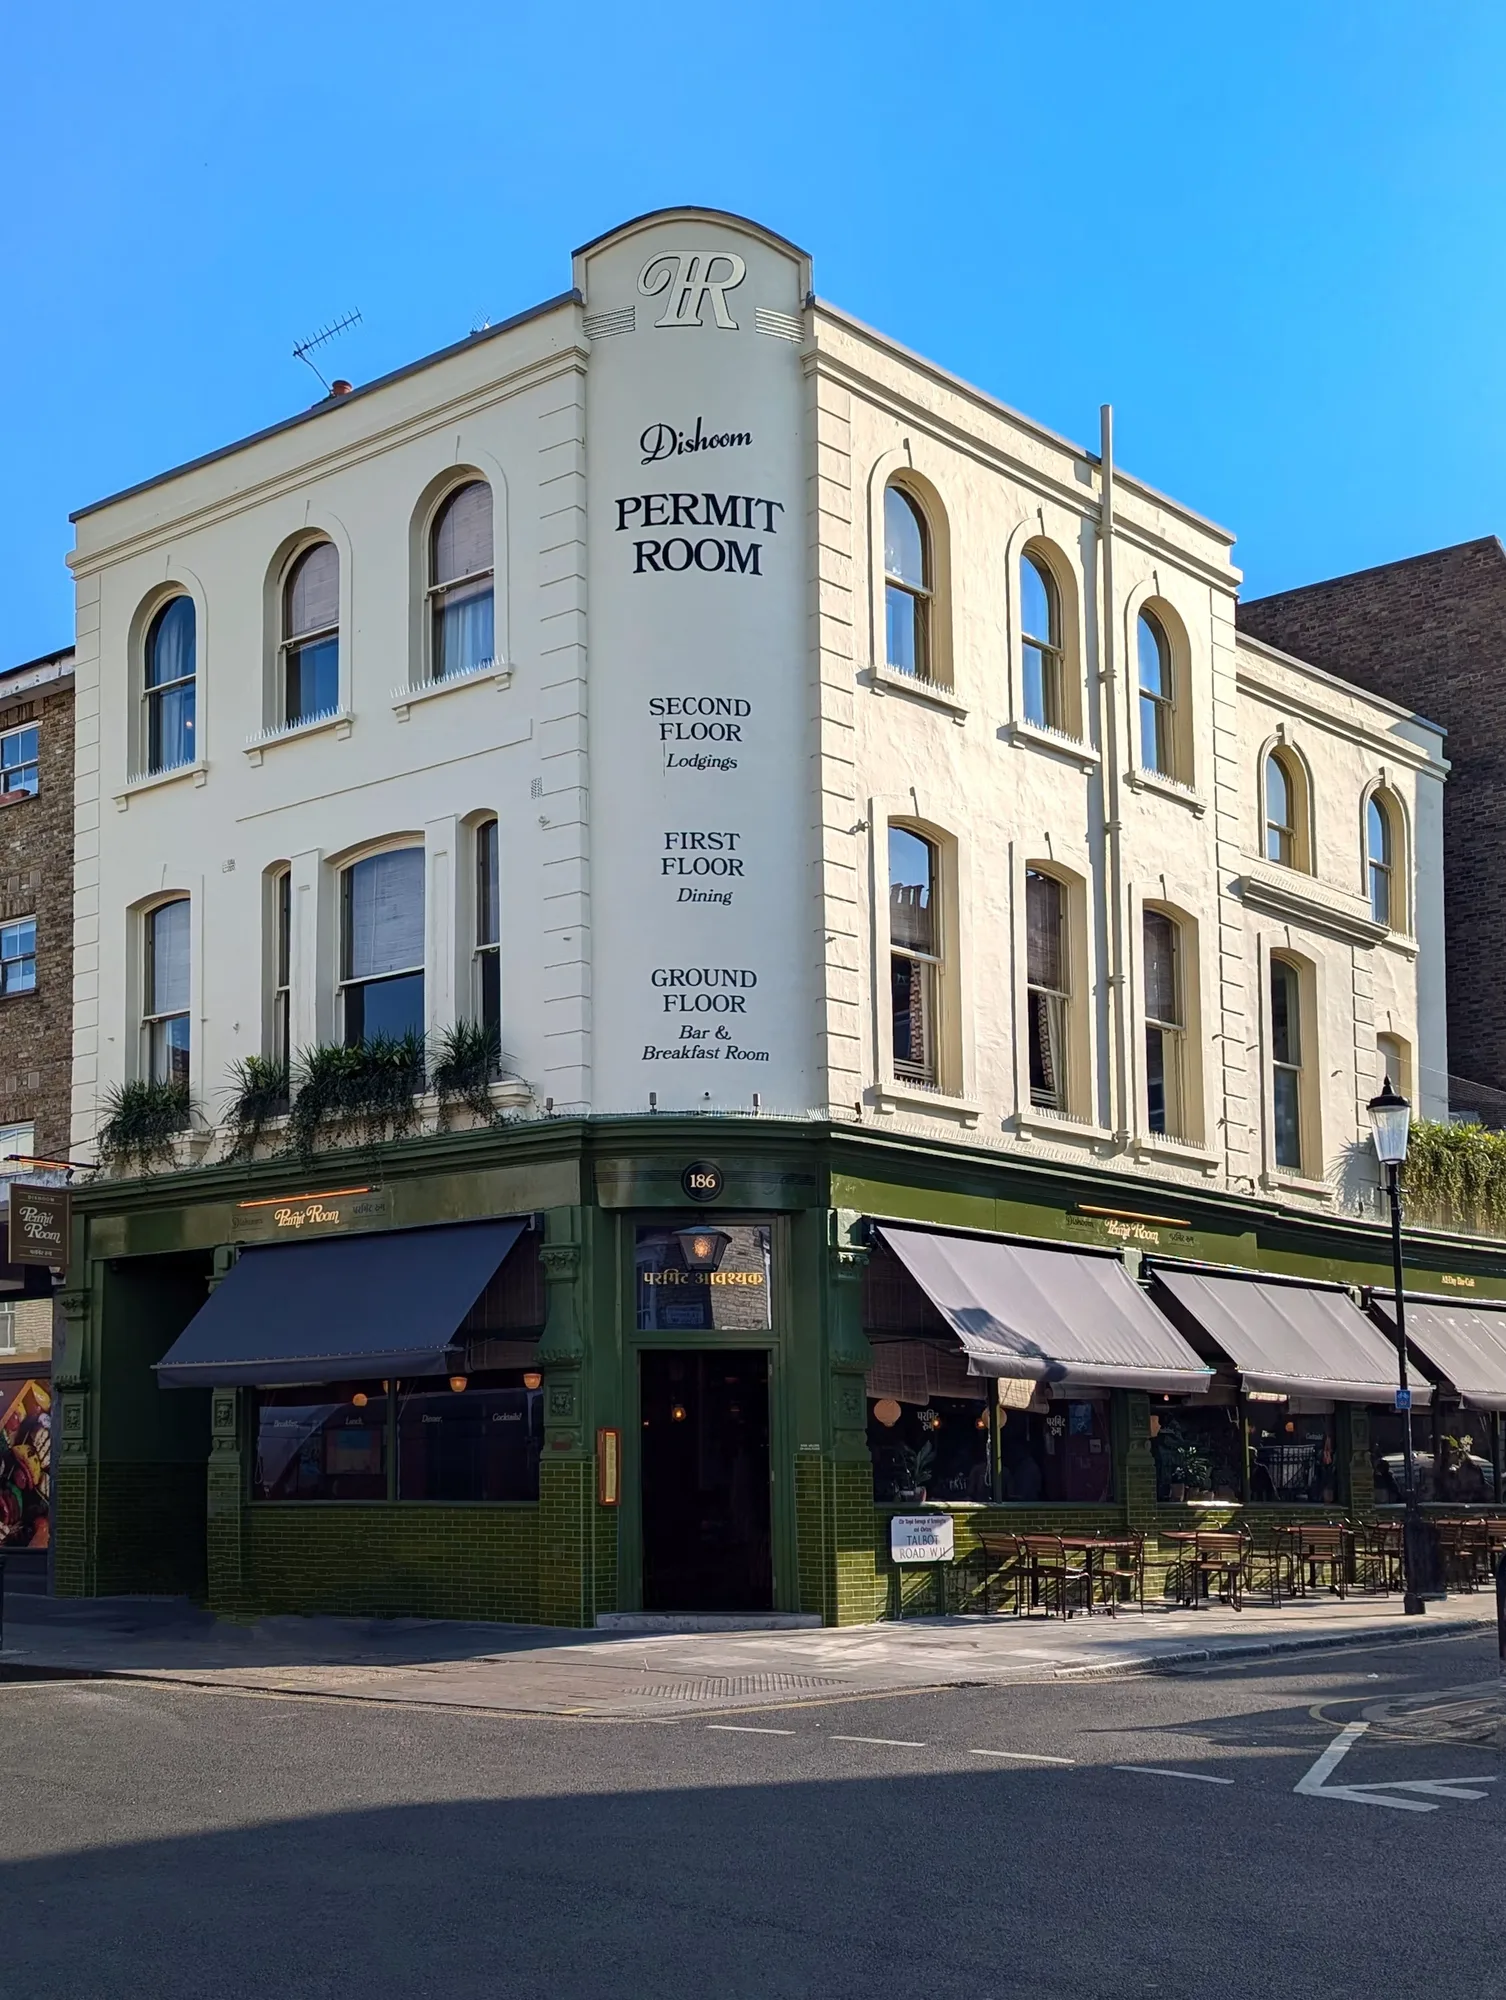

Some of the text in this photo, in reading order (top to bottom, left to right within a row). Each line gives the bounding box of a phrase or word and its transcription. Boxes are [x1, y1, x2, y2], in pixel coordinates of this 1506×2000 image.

[640, 416, 753, 465] Dishoom
[614, 493, 785, 533] PERMIT
[632, 538, 764, 576] ROOM
[649, 697, 751, 717] SECOND
[659, 722, 743, 742] FLOOR
[666, 753, 739, 771] Lodgings
[664, 832, 741, 851] FIRST
[661, 857, 745, 877] FLOOR
[676, 887, 734, 905] Dining
[651, 968, 758, 988] GROUND
[663, 994, 747, 1014] FLOOR
[678, 1025, 732, 1041] Bar &
[641, 1045, 770, 1062] Breakfast Room
[690, 1174, 716, 1188] 186
[19, 1206, 54, 1227] Permit
[274, 1204, 340, 1229] Permit Room
[24, 1222, 61, 1244] Room
[1104, 1218, 1160, 1245] Permit Room
[906, 1535, 939, 1546] TALBOT
[900, 1547, 926, 1559] ROAD
